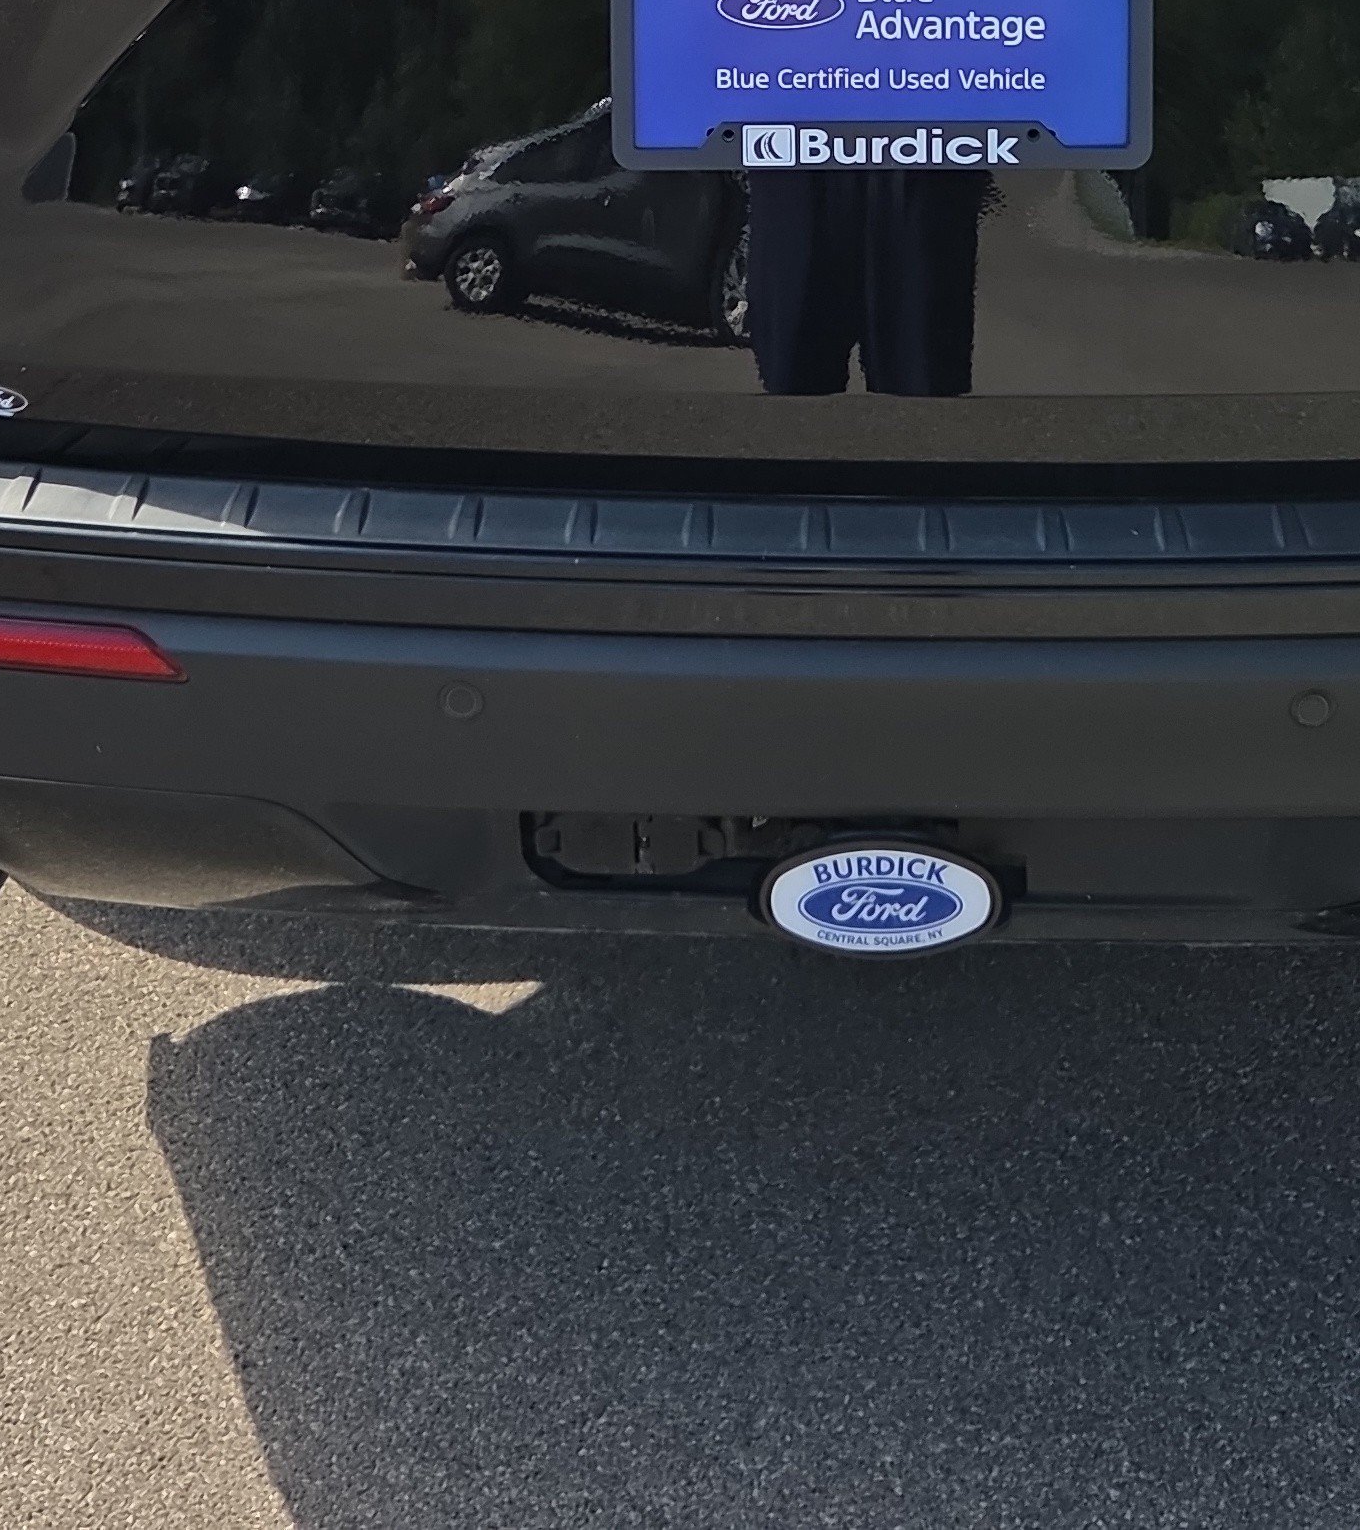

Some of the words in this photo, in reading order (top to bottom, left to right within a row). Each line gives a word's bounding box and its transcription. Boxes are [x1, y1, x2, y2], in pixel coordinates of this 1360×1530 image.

[855, 9, 1047, 47] Advantage
[716, 68, 770, 90] Blue
[777, 67, 880, 90] Certified
[888, 67, 950, 90] Used
[958, 67, 1046, 90] Vehicle
[798, 127, 1021, 166] Burdick
[812, 856, 949, 885] BURDICK
[831, 886, 928, 921] Ford
[816, 929, 870, 946] CENTRAL
[928, 929, 944, 941] NY
